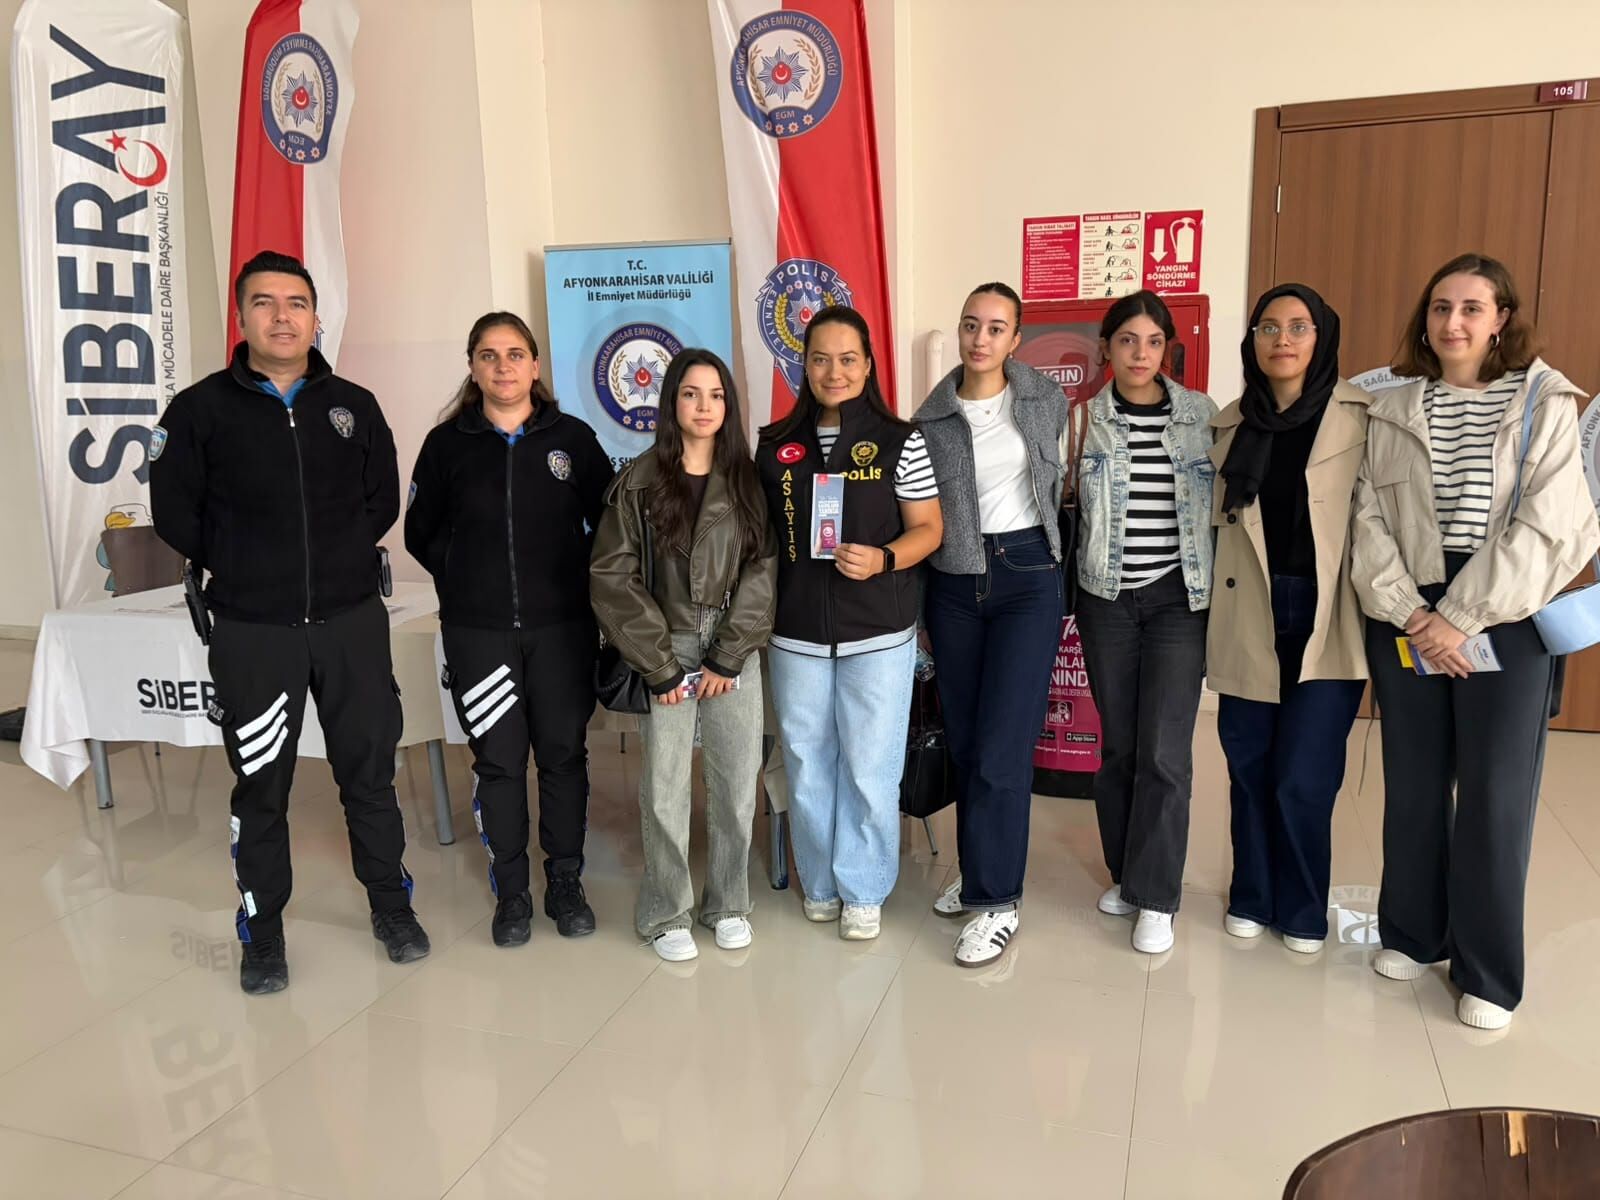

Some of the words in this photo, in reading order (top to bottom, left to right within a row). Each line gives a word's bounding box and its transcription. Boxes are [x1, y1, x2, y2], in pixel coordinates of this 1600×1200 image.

[1553, 86, 1574, 96] 105
[775, 110, 795, 120] EGM
[154, 192, 173, 267] BAŞKANLIĞI
[49, 23, 166, 485] SİBERAY
[627, 260, 647, 270] T.C.
[1155, 264, 1189, 273] YANGIN
[563, 273, 665, 289] AFYONKARAHİSAR
[666, 270, 714, 285] VALİLİĞİ
[776, 263, 829, 285] POLİS
[1146, 272, 1196, 281] SÖNDÜRME
[157, 270, 173, 308] DAİRE
[1155, 280, 1186, 288] CİHAZI
[587, 290, 594, 302] İl
[596, 290, 635, 303] Emniyet
[637, 288, 692, 302] Müdürlüğü
[161, 310, 176, 380] MÜCADELE
[1049, 369, 1079, 382] GIN
[637, 409, 654, 417] EGM
[1581, 403, 1600, 449] AFYONK
[781, 469, 797, 562] ASAYİŞ
[1050, 669, 1089, 687] NIND
